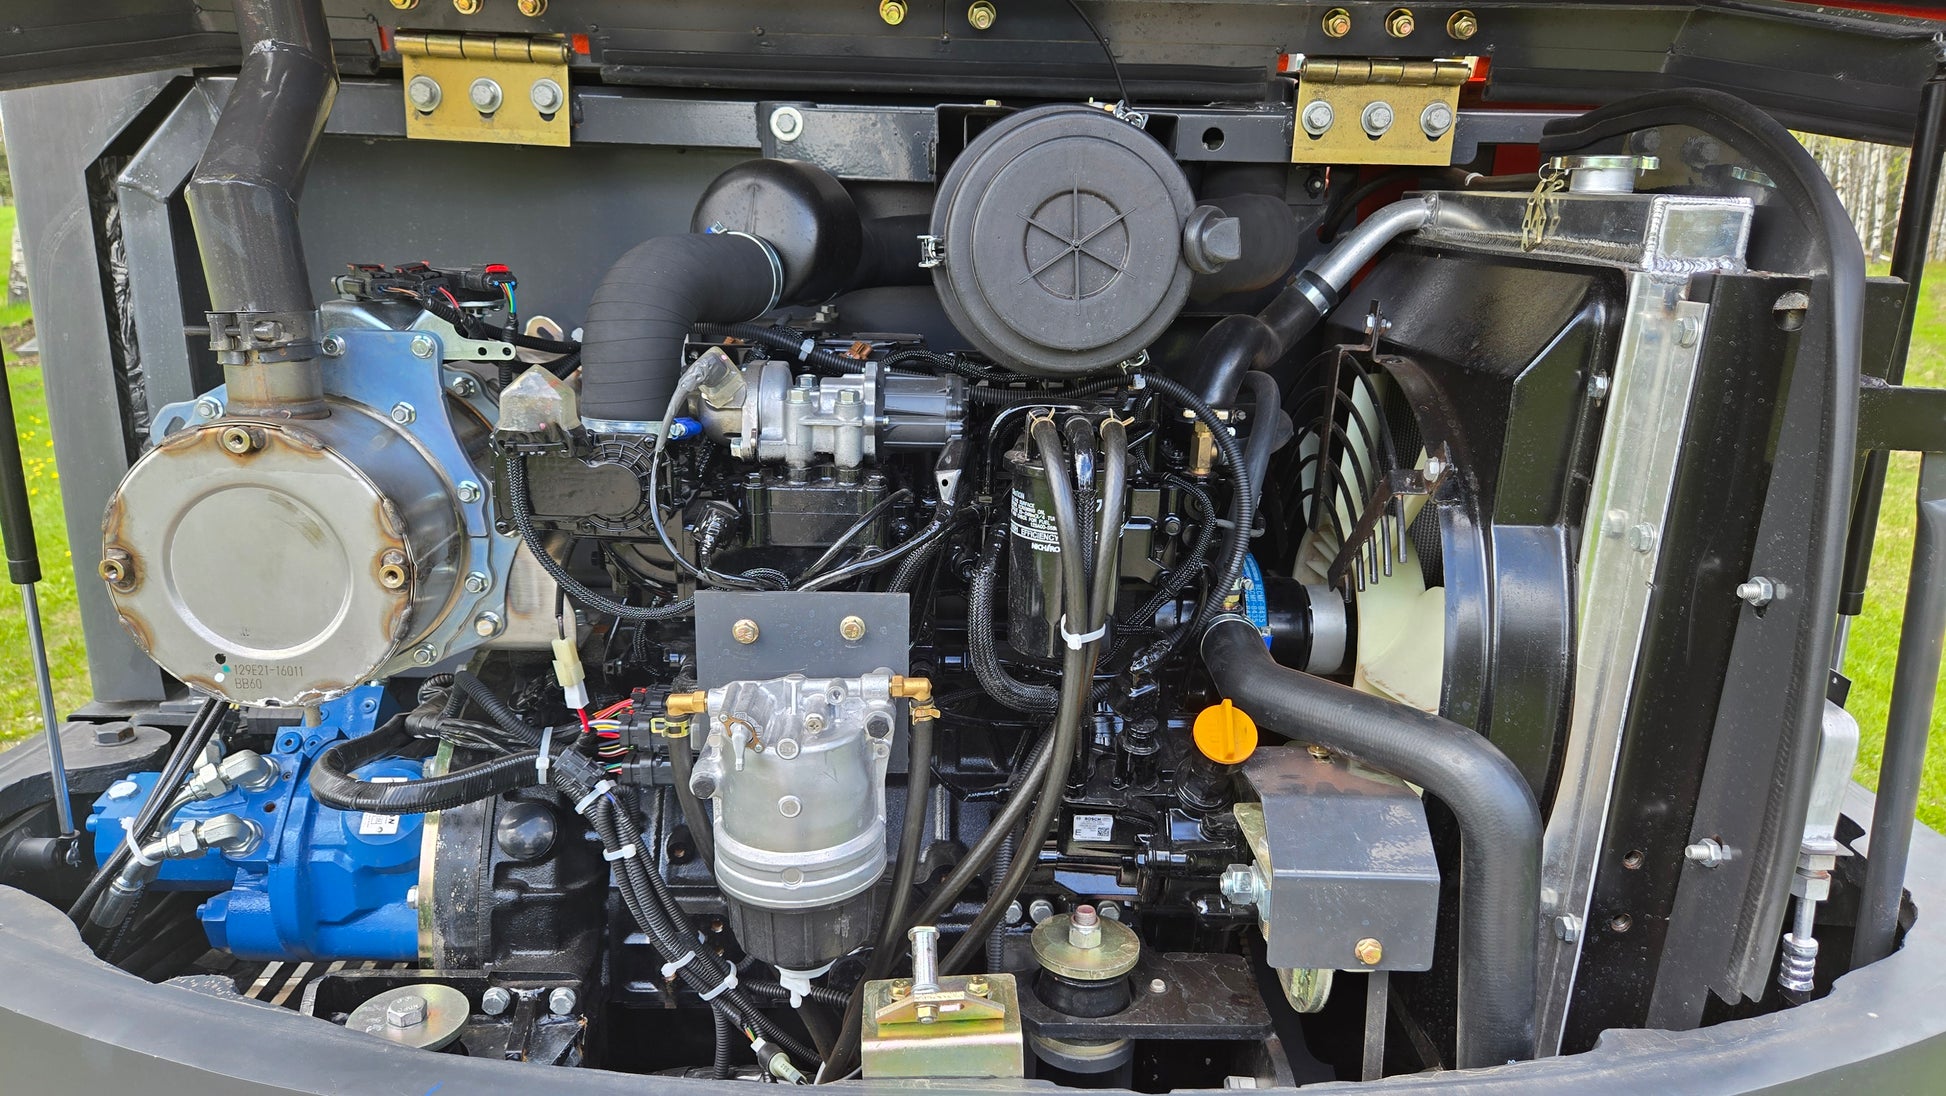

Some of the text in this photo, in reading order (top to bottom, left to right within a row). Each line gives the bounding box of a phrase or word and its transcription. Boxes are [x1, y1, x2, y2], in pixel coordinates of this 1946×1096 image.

[1021, 528, 1059, 541] EFFICIENCY
[235, 665, 303, 677] 129E21-16011
[235, 678, 262, 689] BB60
